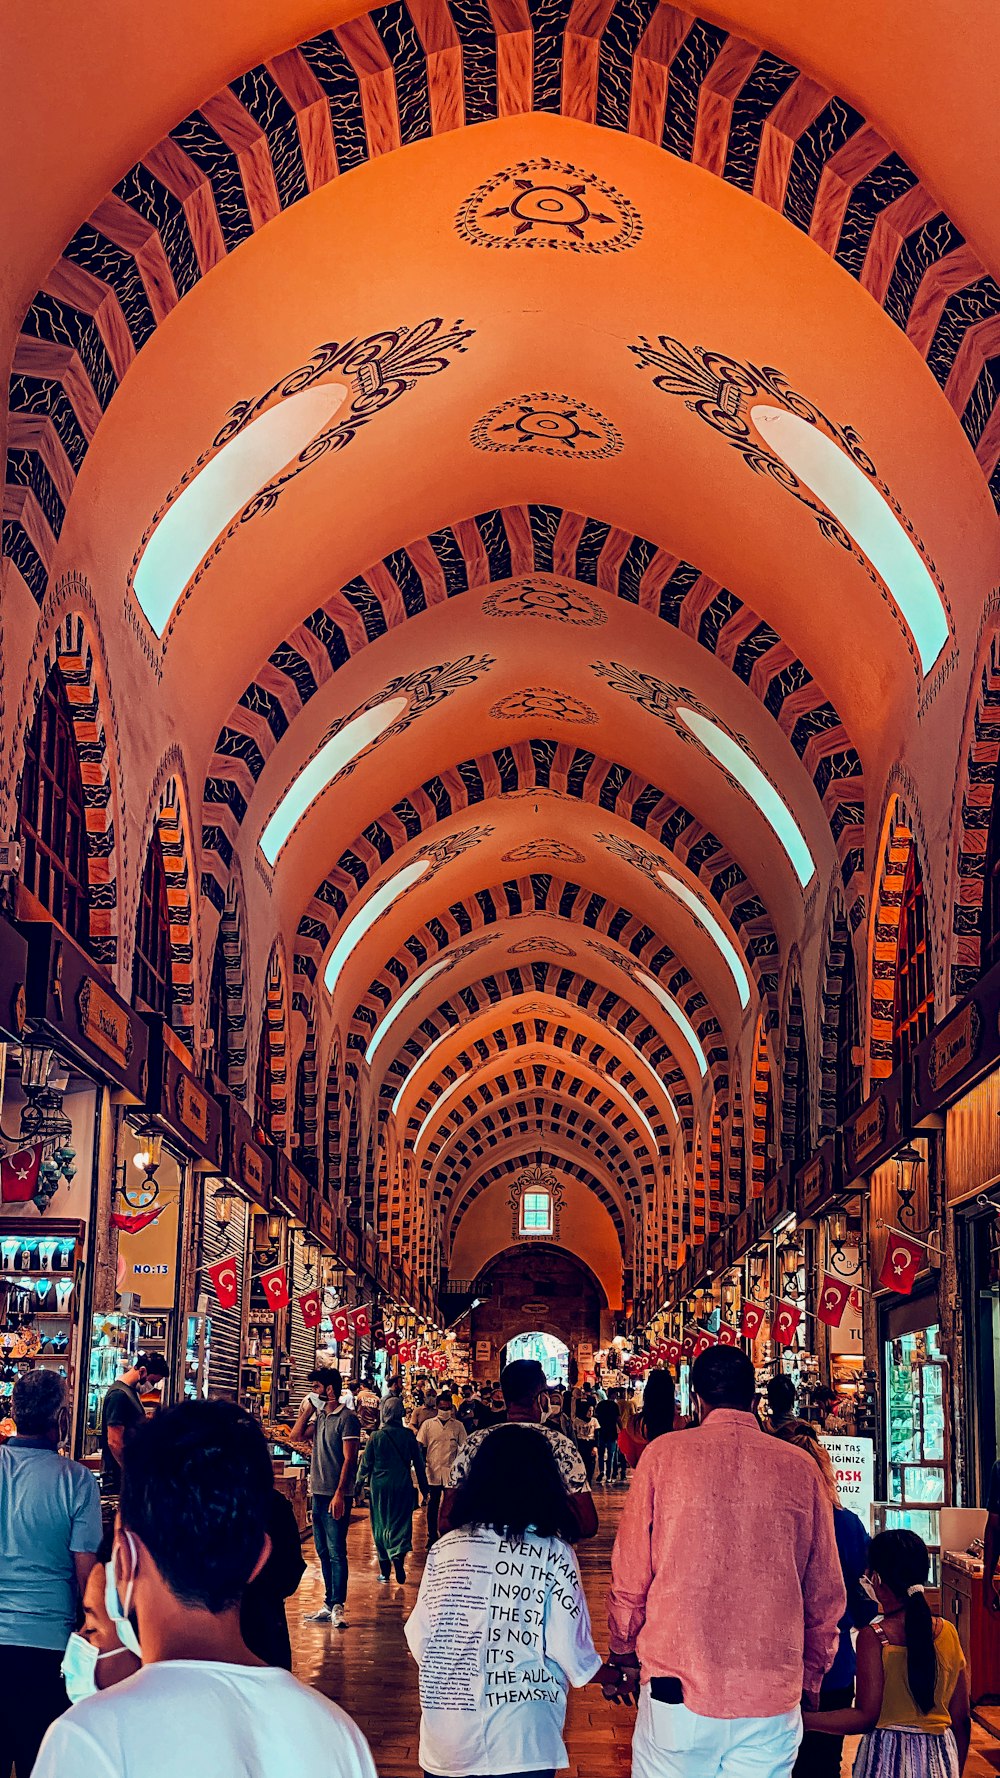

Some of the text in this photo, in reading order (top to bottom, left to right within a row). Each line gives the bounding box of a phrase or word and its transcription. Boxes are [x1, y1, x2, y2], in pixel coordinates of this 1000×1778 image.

[134, 1265, 168, 1274] NO:13
[498, 1541, 542, 1559] EVEN
[495, 1561, 523, 1577] ON
[490, 1605, 520, 1623] THE
[488, 1628, 501, 1642] IS
[507, 1629, 539, 1648] NOT
[486, 1650, 514, 1664] IT'S
[486, 1671, 517, 1686] THE
